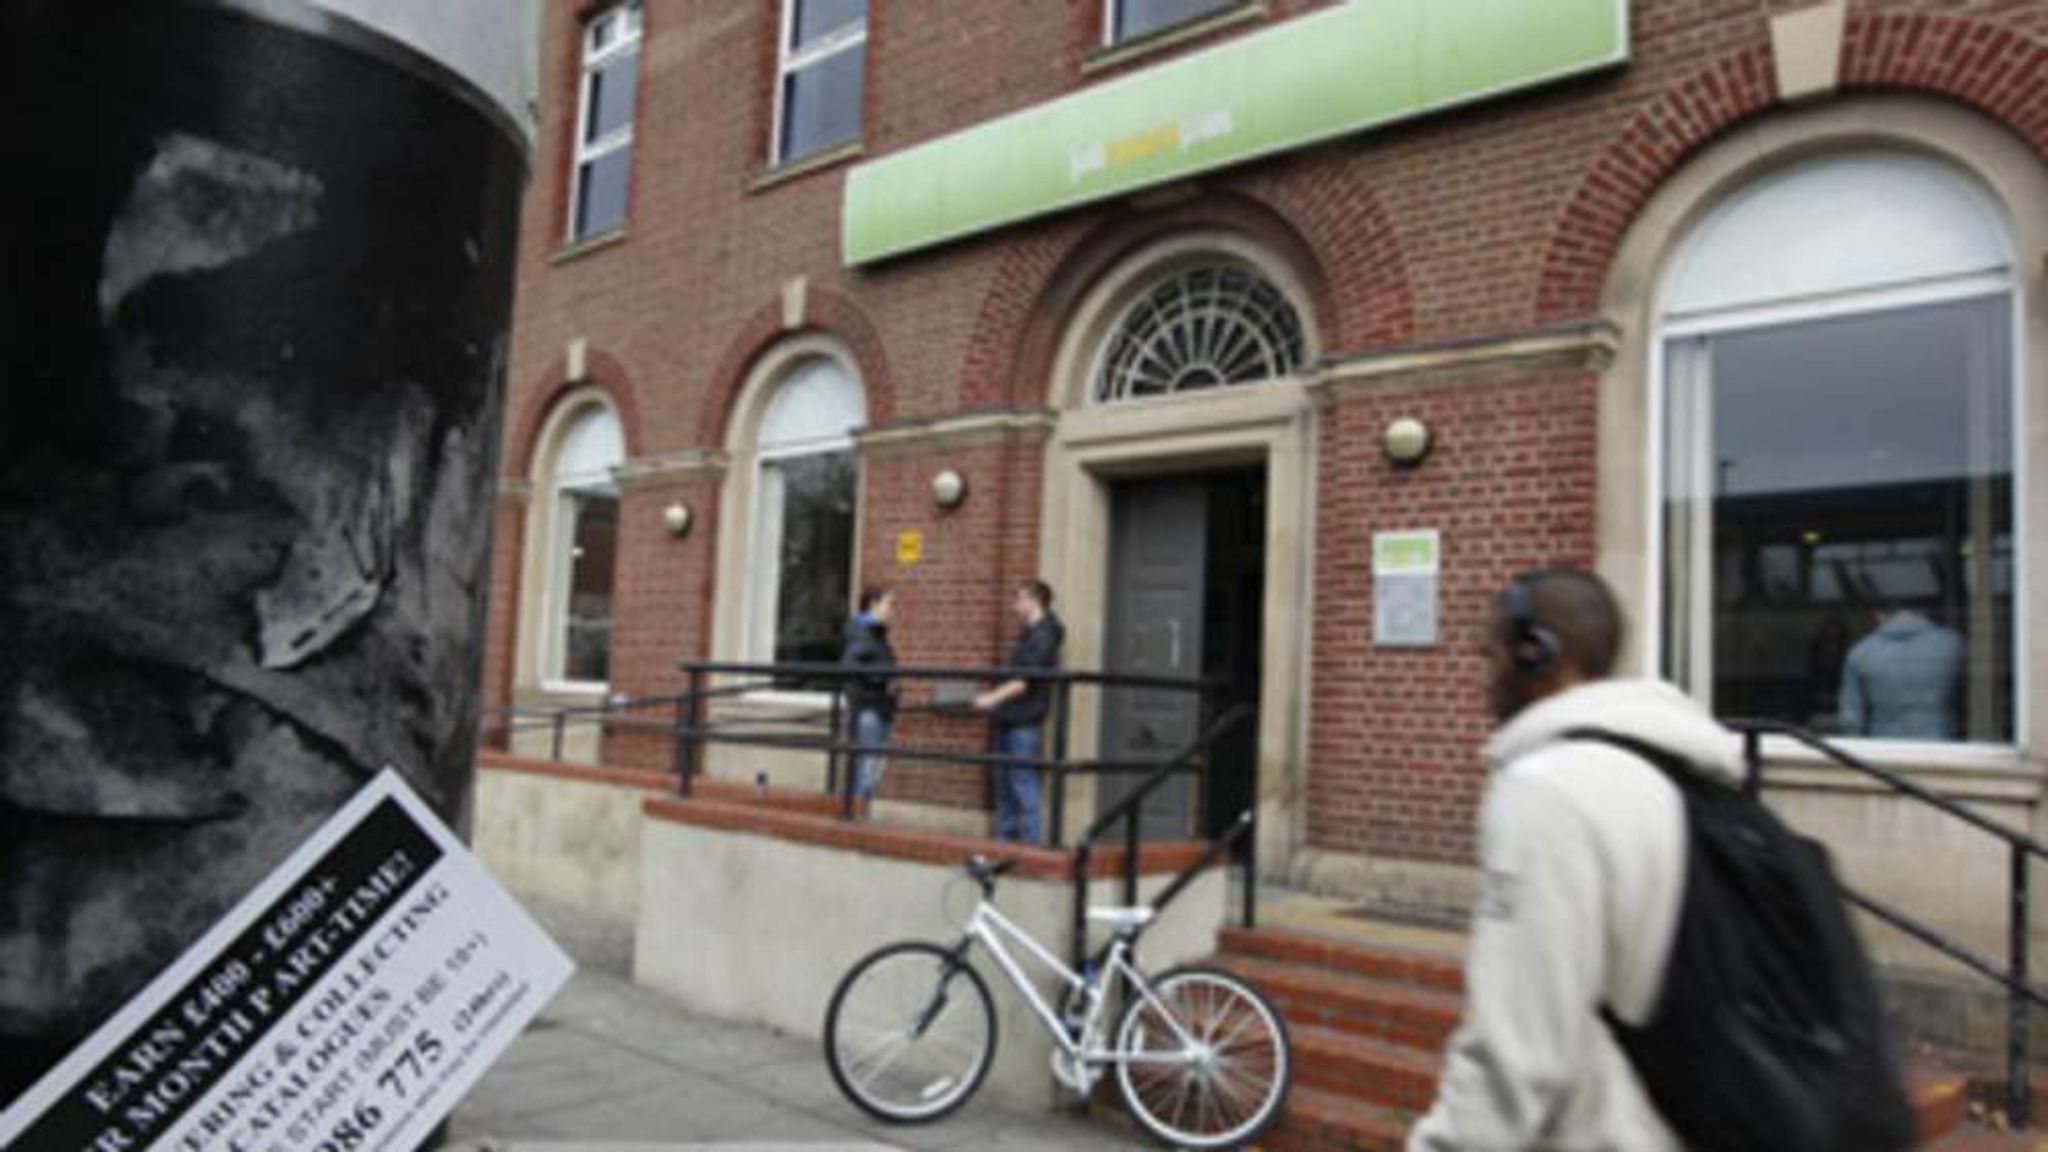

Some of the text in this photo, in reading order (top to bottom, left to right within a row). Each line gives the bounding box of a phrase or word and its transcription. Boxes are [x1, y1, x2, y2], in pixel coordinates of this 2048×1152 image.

[86, 1019, 186, 1112] EARN
[124, 1010, 252, 1131] MONTH
[175, 1062, 273, 1152] ERING
[275, 1043, 297, 1066] &
[297, 882, 449, 1039] COLLECTING
[228, 988, 391, 1152] CATALOGUES
[377, 1029, 442, 1098] 775
[286, 1068, 354, 1143] START
